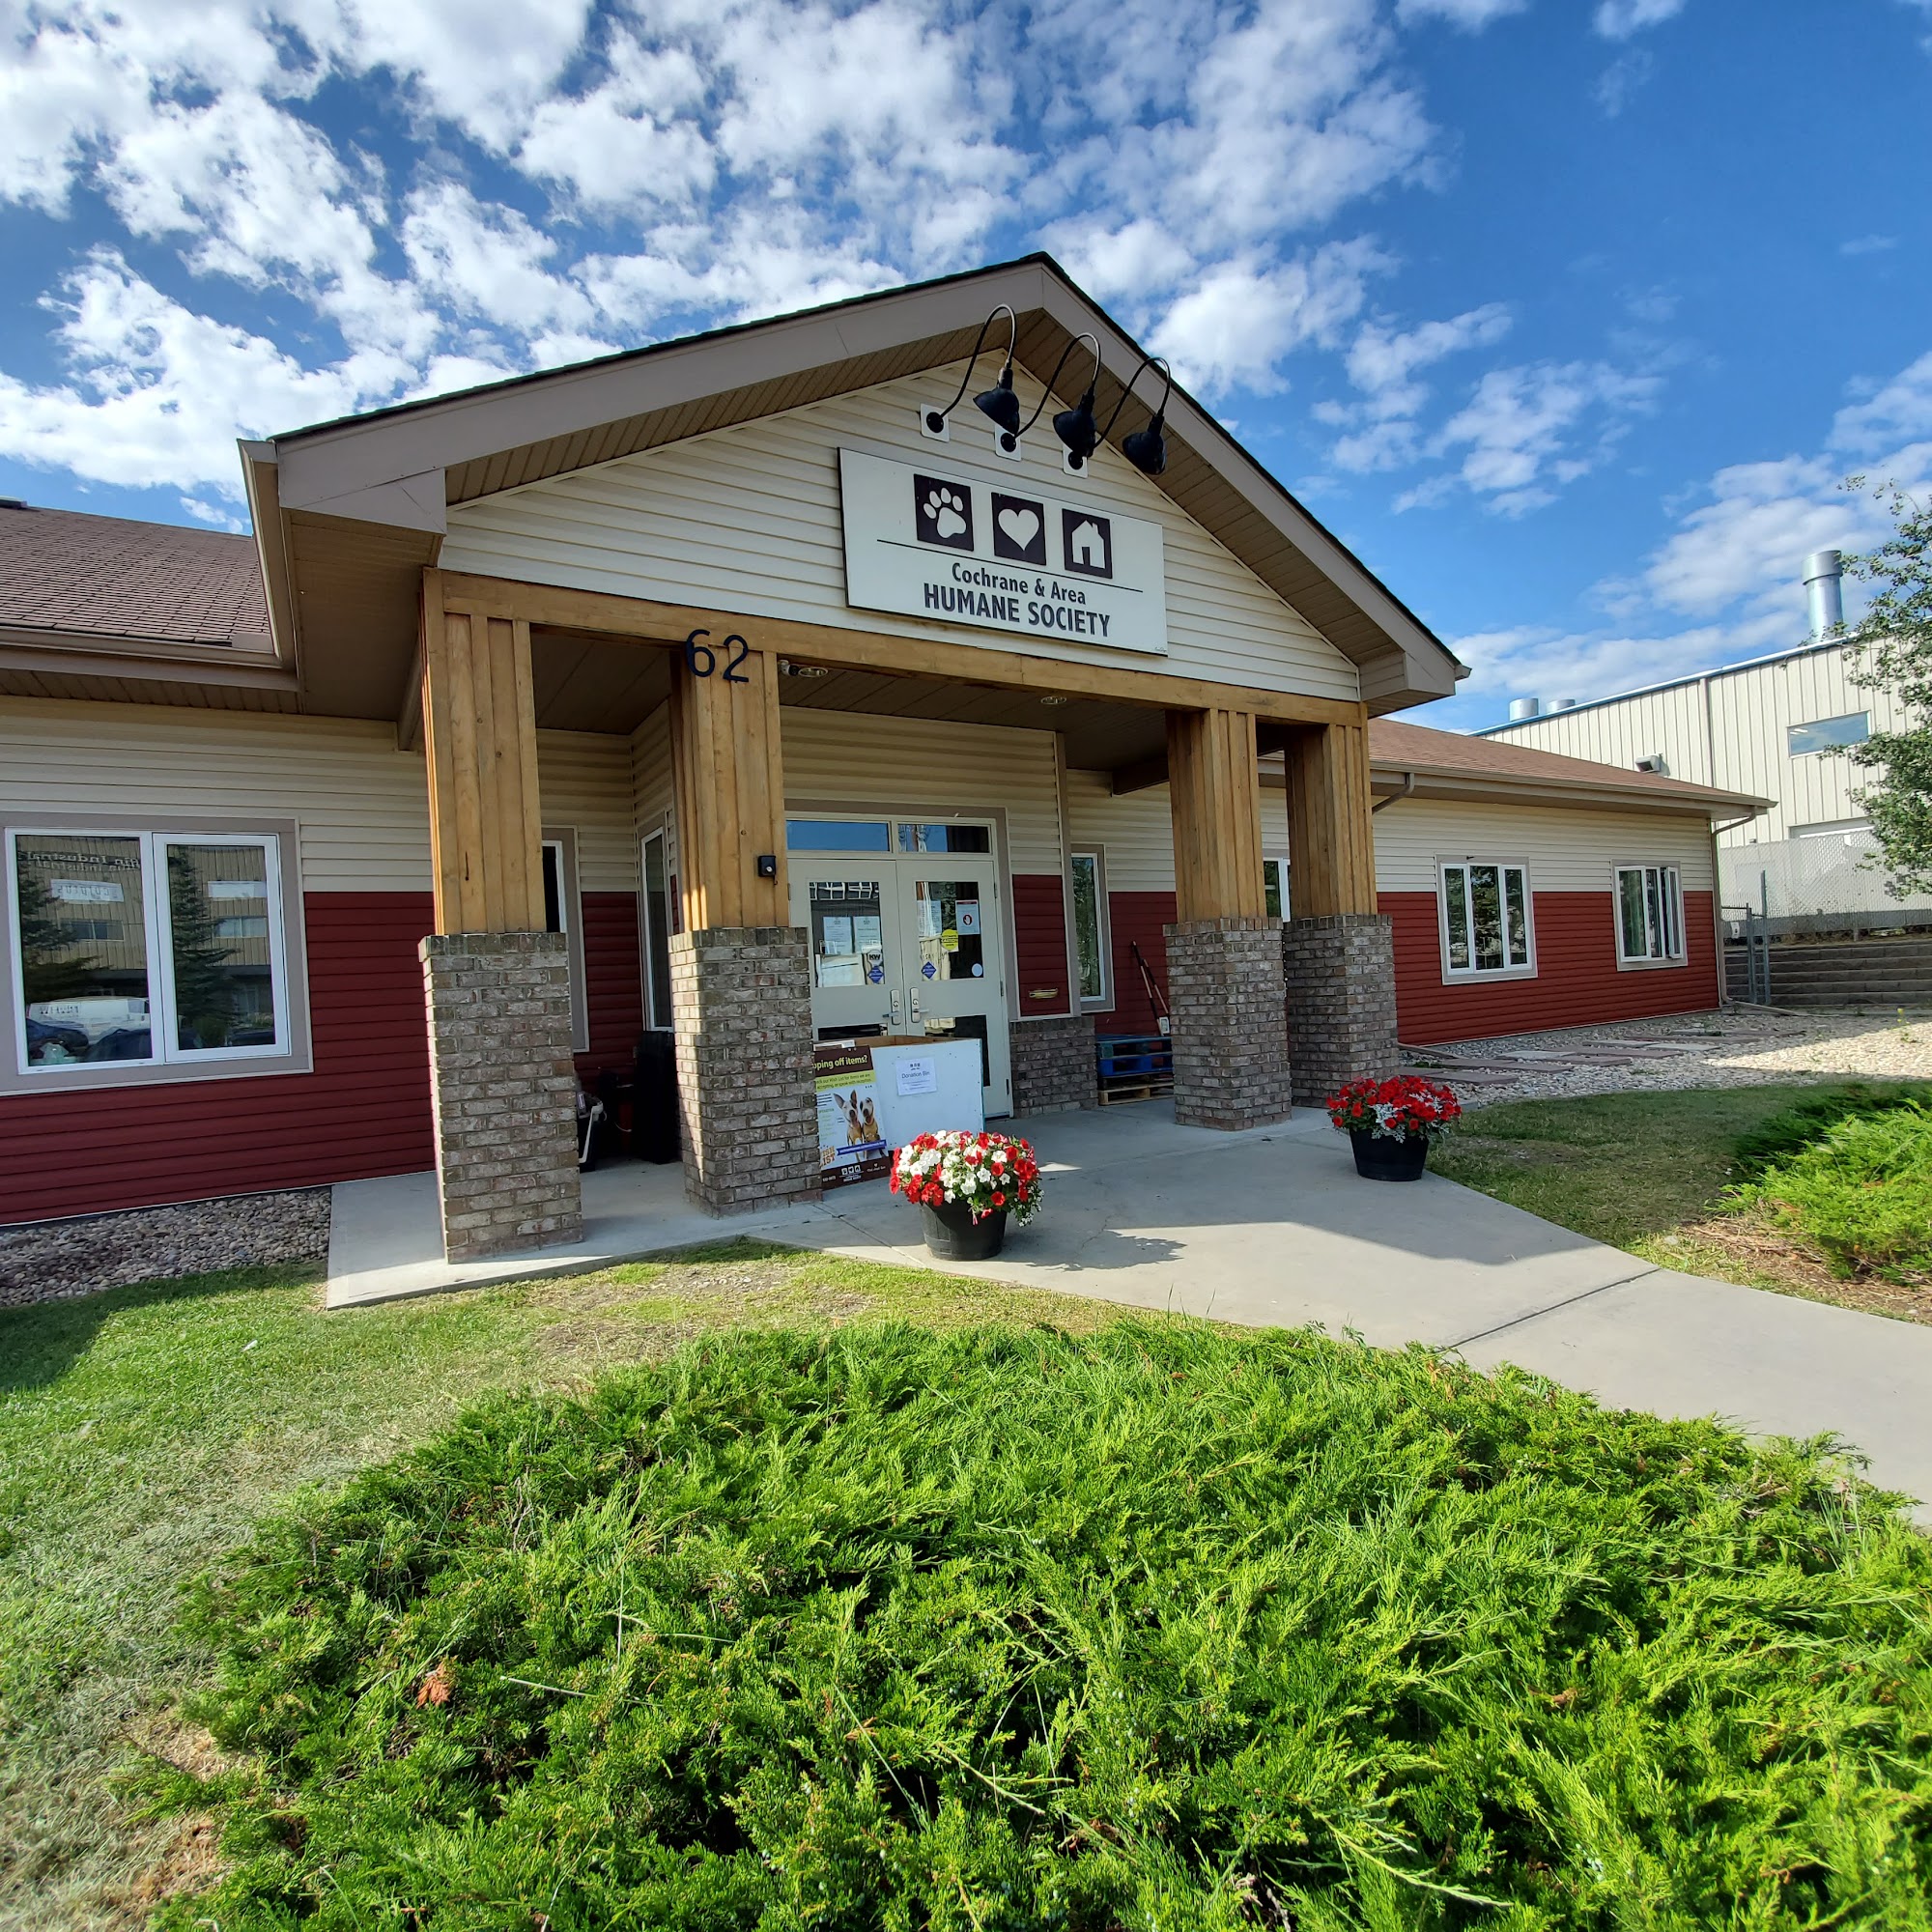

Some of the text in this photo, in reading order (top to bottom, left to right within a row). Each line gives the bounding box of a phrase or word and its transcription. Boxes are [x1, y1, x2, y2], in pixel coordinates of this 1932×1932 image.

[952, 562, 1087, 605] Cochrane & Area
[923, 582, 1111, 638] HUMANE SOCIETY
[686, 629, 750, 683] 62
[834, 1057, 845, 1066] off
[845, 1055, 867, 1065] items?
